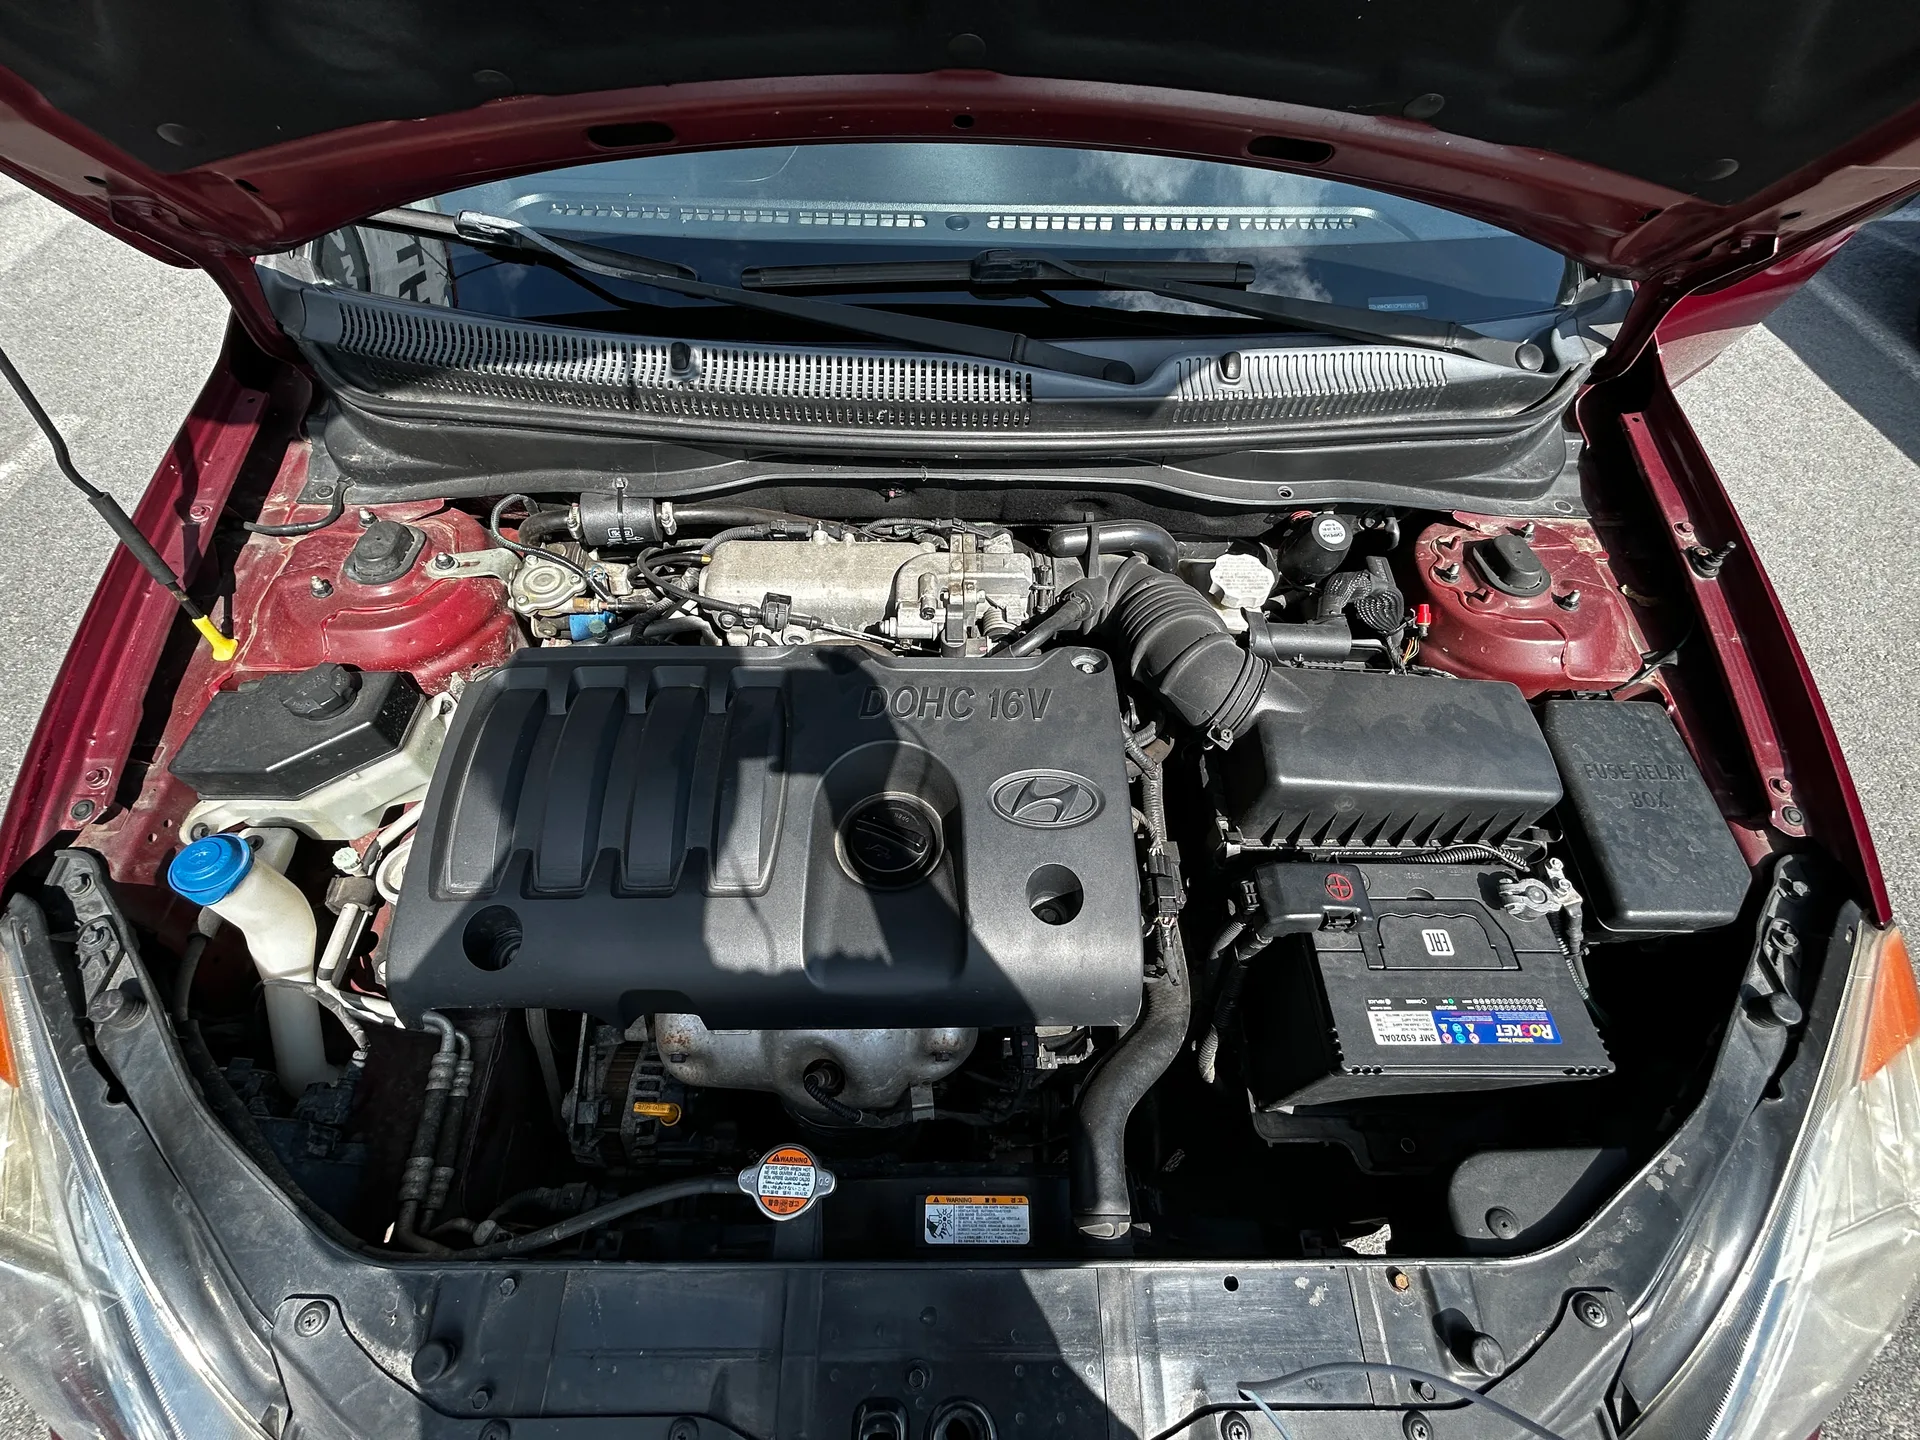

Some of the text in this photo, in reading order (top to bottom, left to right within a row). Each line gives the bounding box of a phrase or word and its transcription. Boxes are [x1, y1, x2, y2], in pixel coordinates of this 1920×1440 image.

[859, 685, 1053, 721] DOHC 16V
[1629, 790, 1669, 809] BOX
[1379, 1034, 1436, 1042] SMF 65D20AL
[1496, 1024, 1554, 1039] ROCKET
[780, 1156, 808, 1164] WARNING
